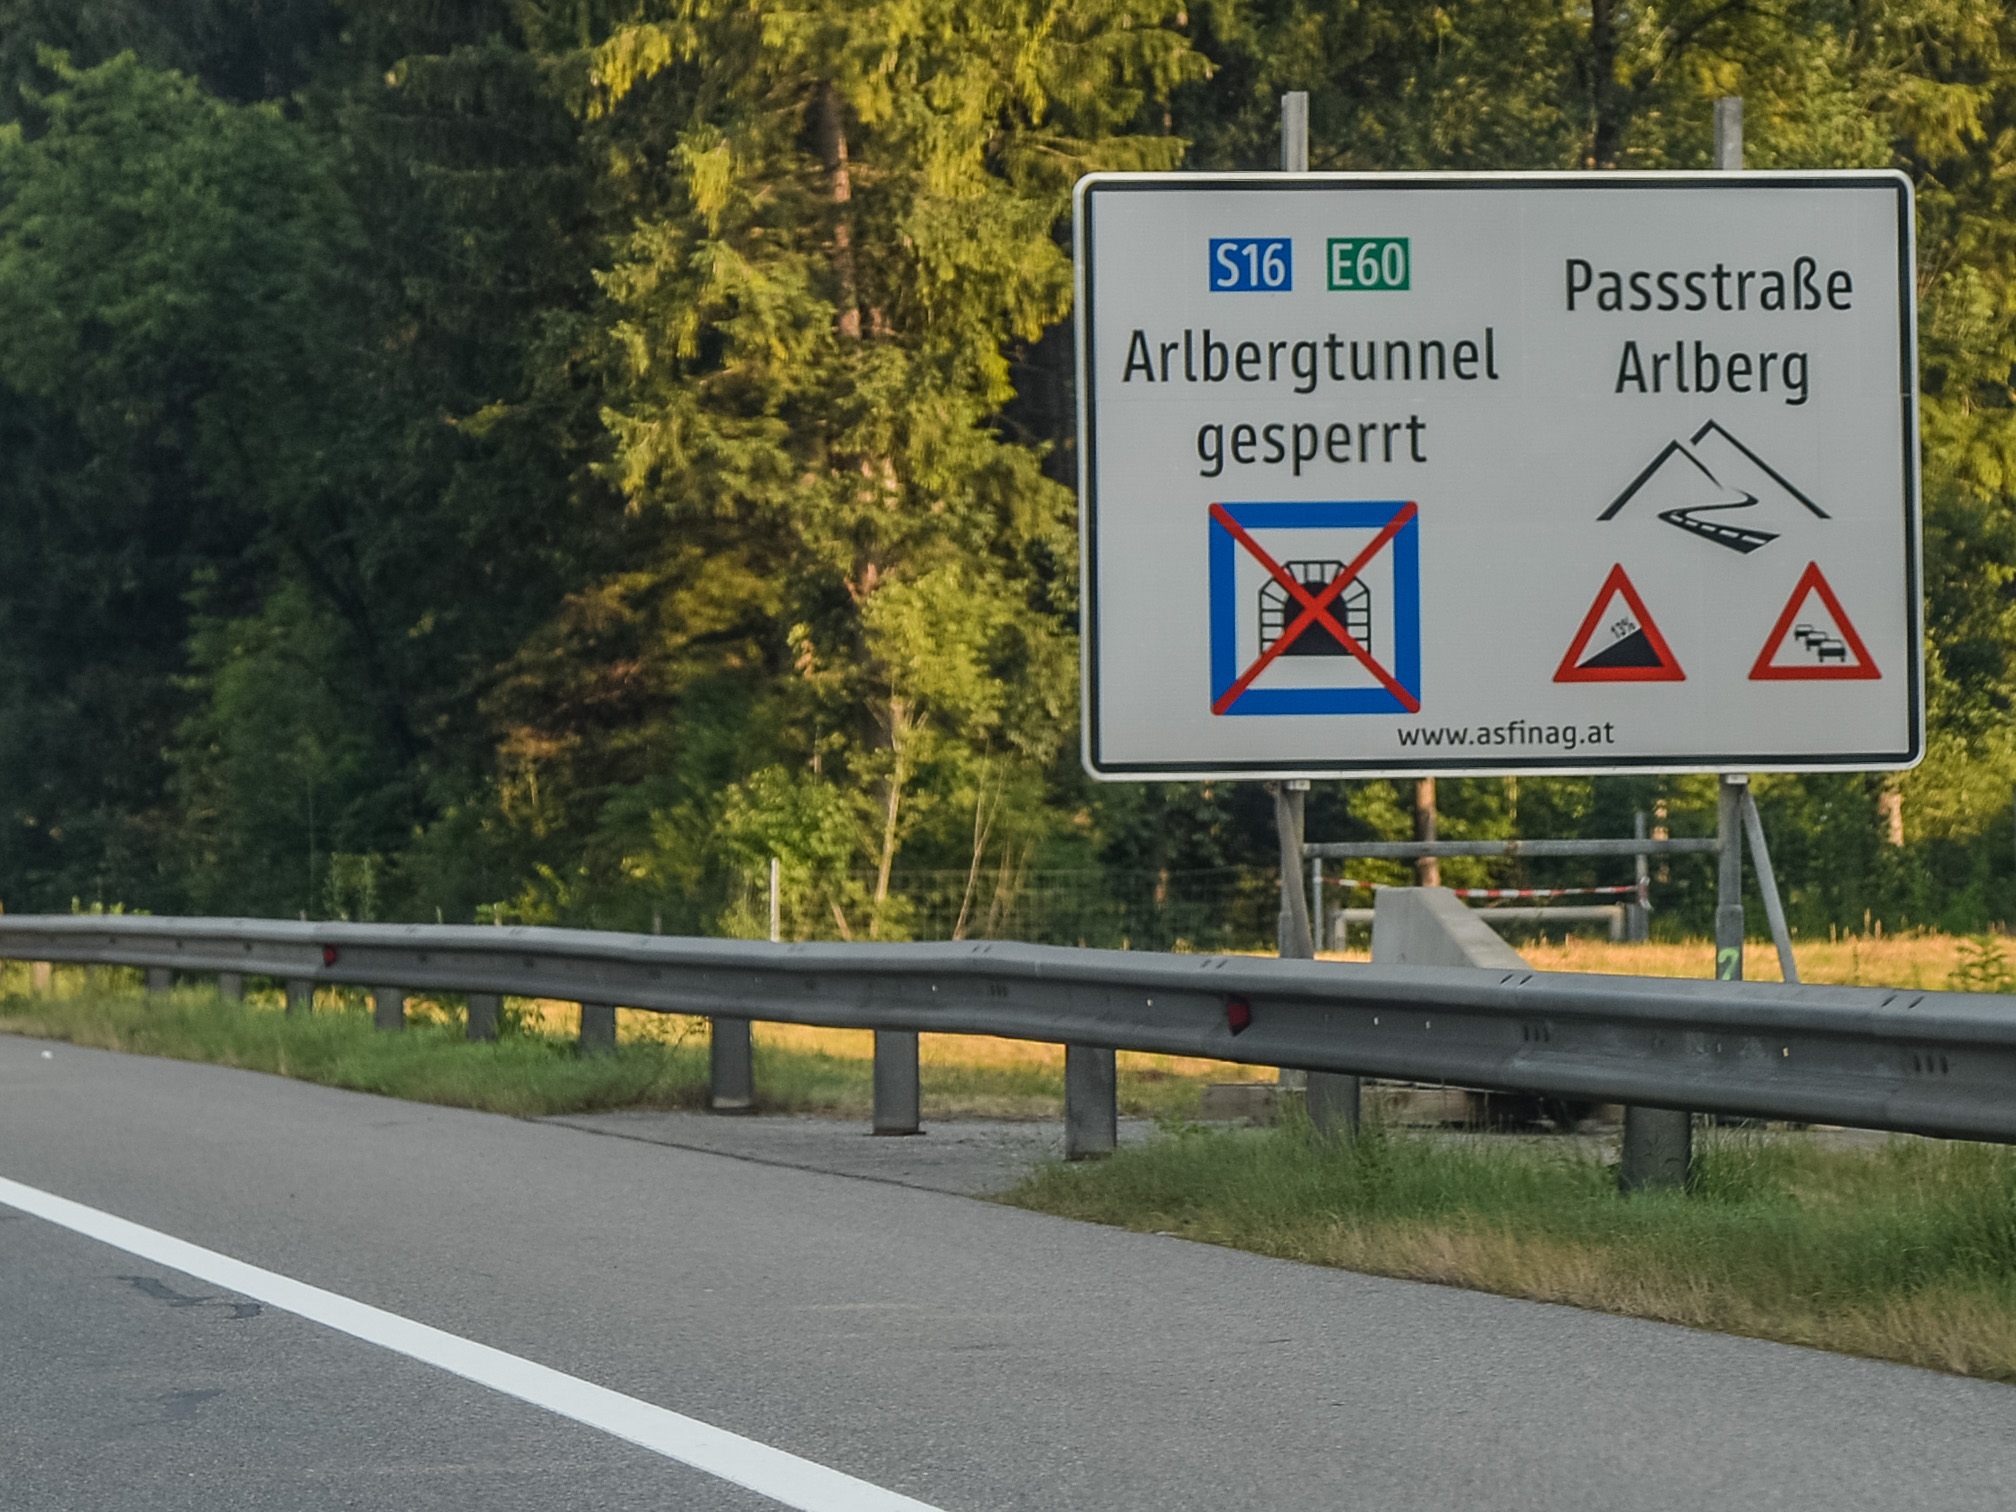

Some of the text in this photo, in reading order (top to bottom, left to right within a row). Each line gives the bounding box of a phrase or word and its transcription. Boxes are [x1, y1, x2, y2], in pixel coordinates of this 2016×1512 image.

[1216, 242, 1285, 287] S16
[1332, 242, 1404, 286] E60
[1565, 255, 1853, 312] Passstraße
[1122, 327, 1499, 395] Arlbergtunnel
[1614, 340, 1809, 406] Arlberg
[1197, 414, 1427, 478] gesperrt
[1397, 719, 1615, 750] www.asfinag.at
